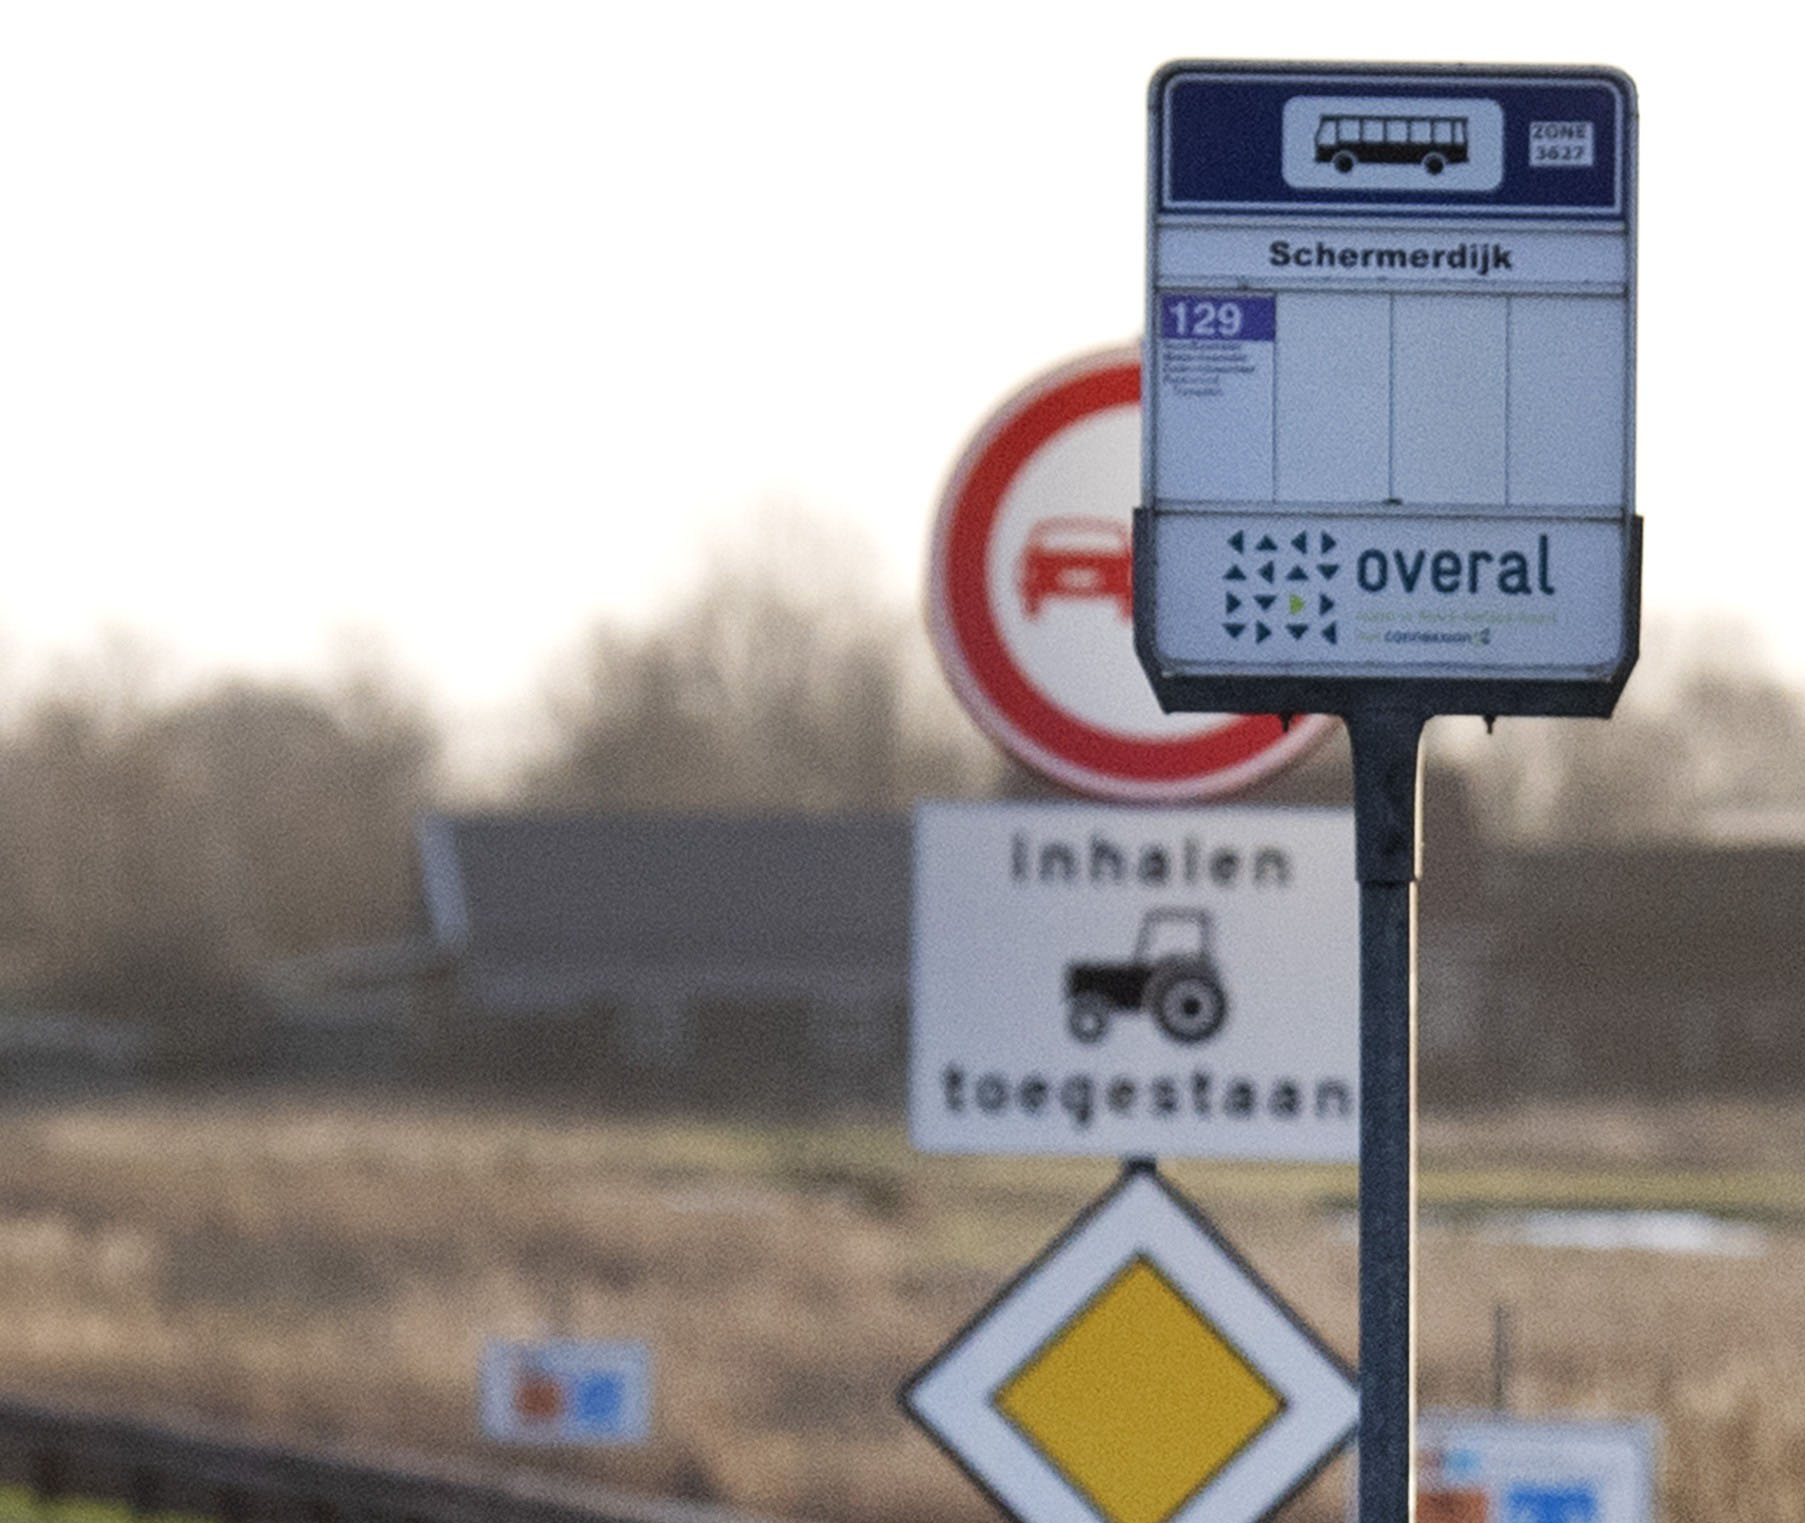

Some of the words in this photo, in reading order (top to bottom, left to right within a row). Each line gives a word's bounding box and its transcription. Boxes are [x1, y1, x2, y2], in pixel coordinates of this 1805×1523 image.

[1532, 124, 1586, 139] ZONE
[1535, 145, 1584, 160] 3627
[1268, 240, 1513, 275] Schermerdijk
[1168, 301, 1242, 336] 129
[1356, 533, 1556, 596] overal
[1010, 831, 1293, 890] Inhalen
[941, 1060, 1353, 1131] toegestaan
